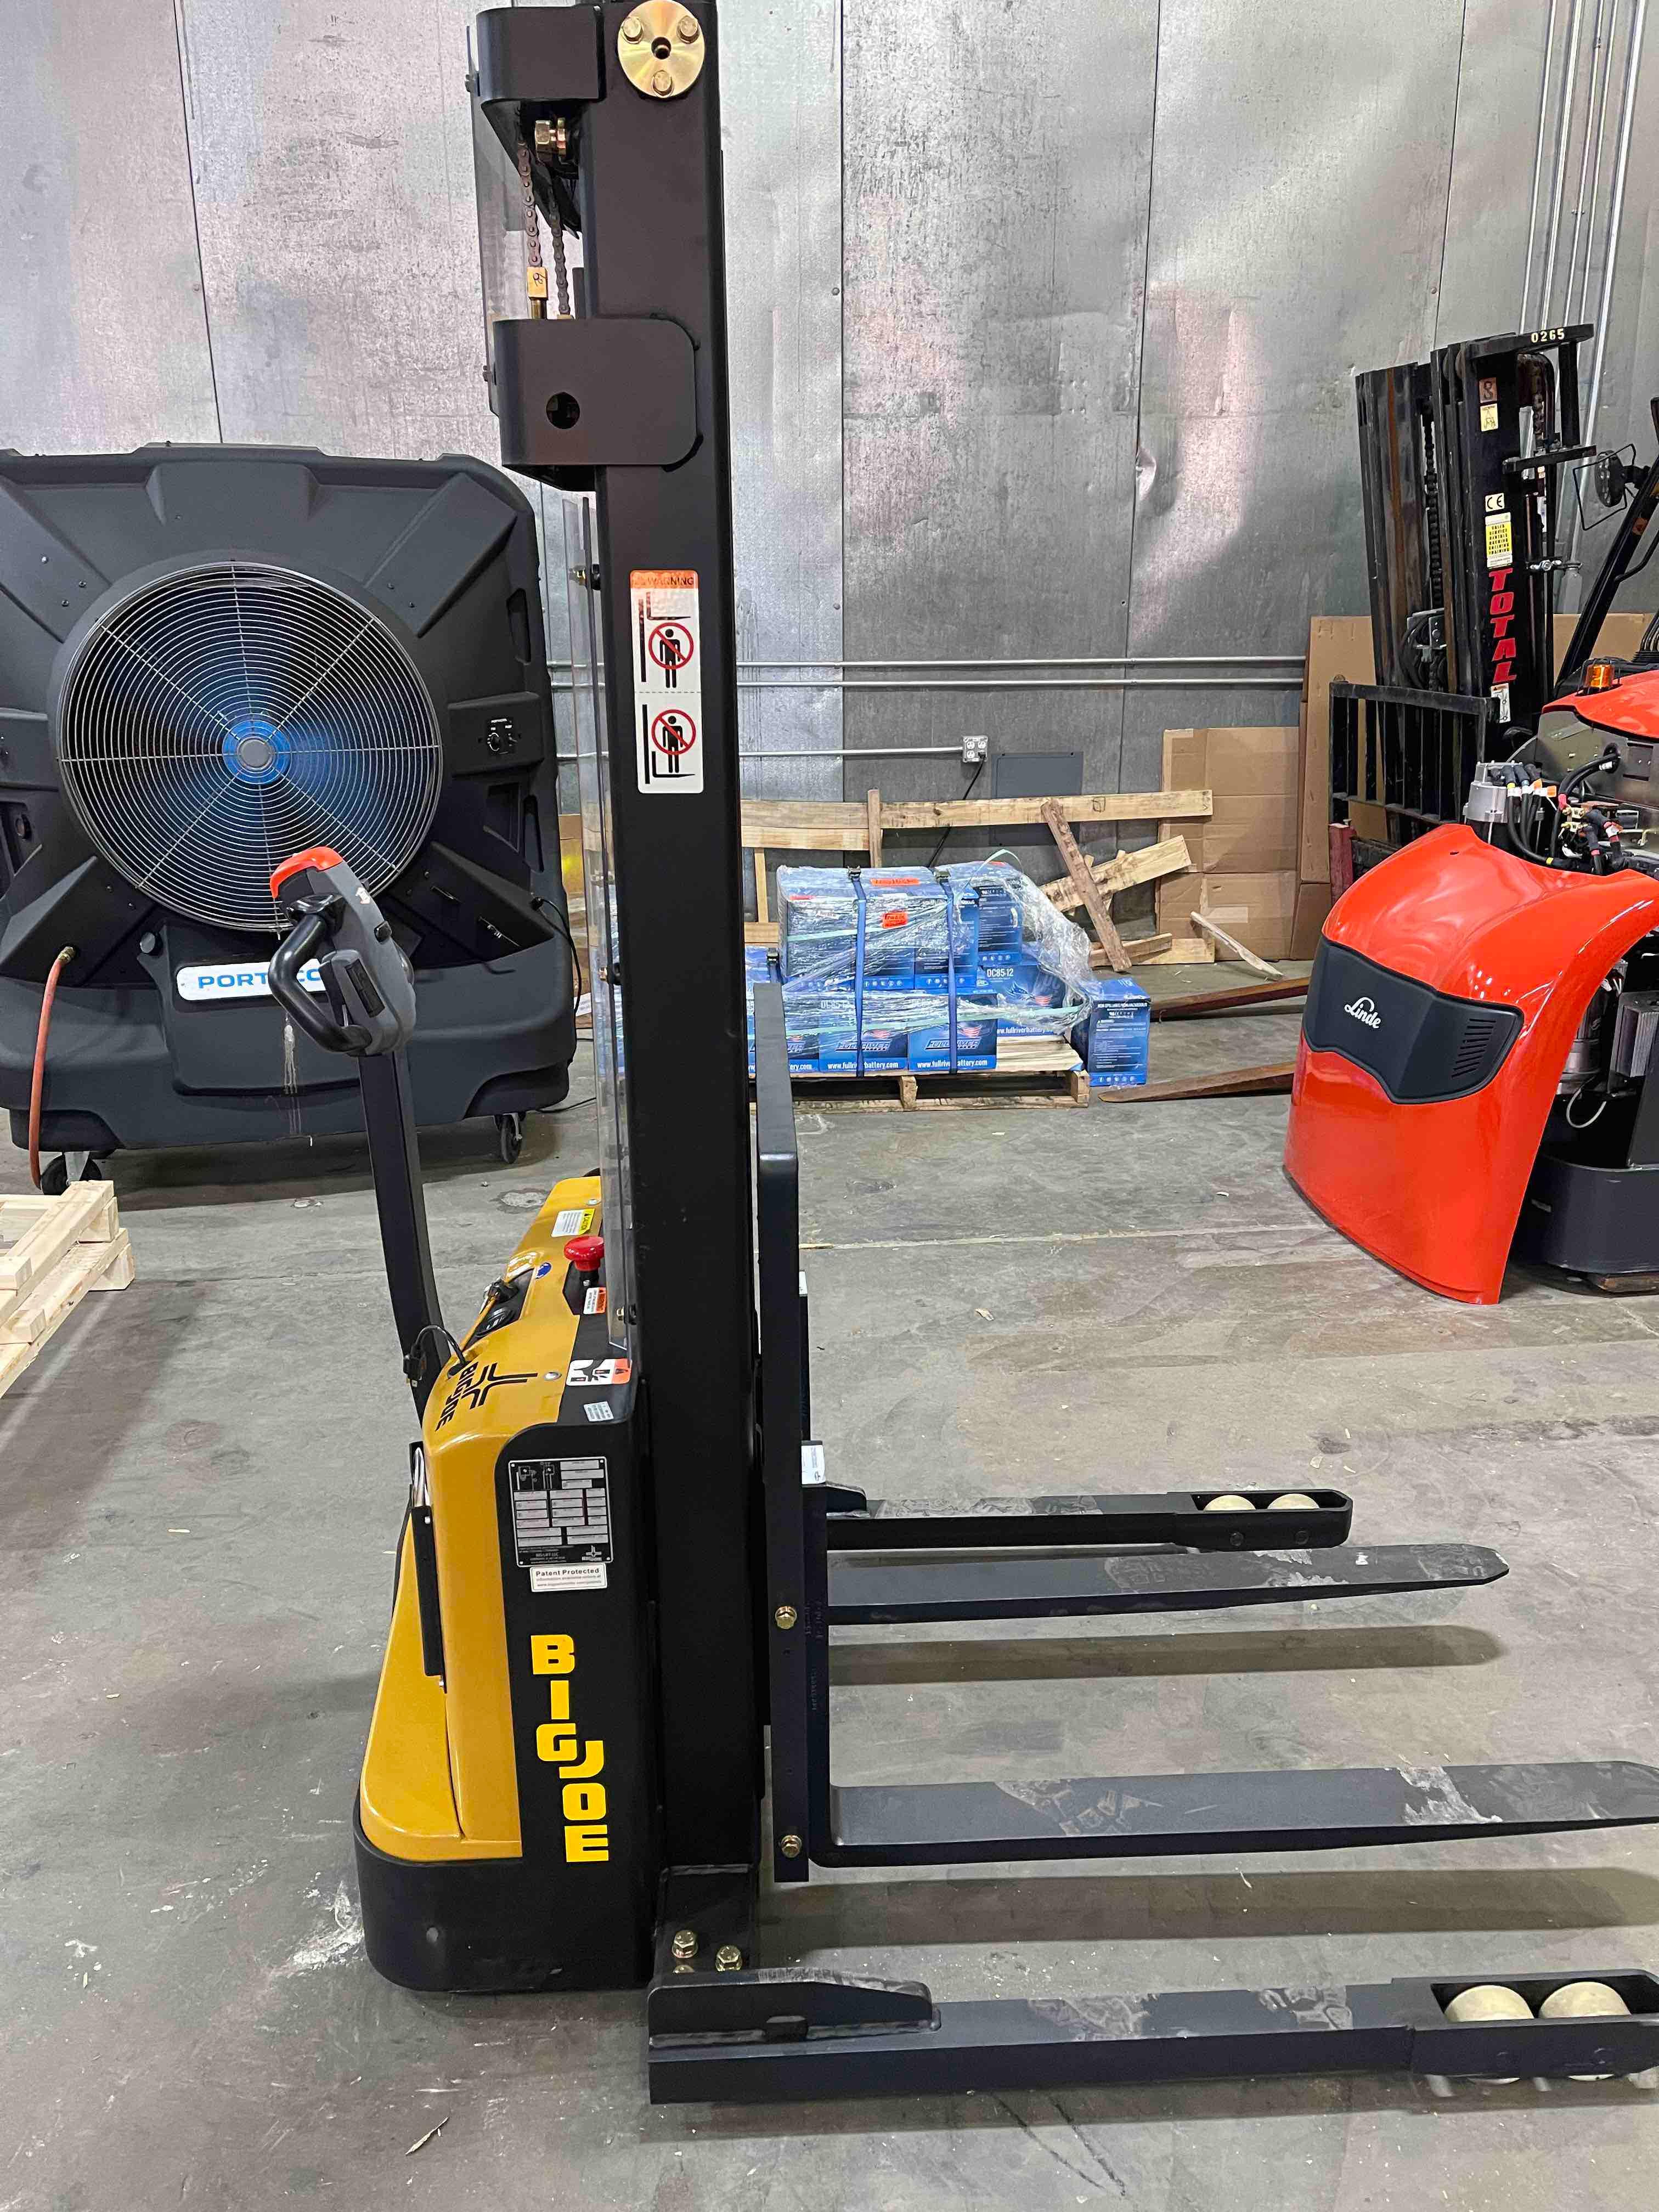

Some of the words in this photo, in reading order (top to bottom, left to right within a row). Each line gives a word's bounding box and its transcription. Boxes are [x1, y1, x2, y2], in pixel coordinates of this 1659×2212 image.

[1531, 328, 1565, 343] 0265
[1488, 568, 1516, 682] TOTAL
[1344, 996, 1381, 1029] Linde
[827, 1061, 899, 1071] www.fullribattery.com
[917, 1059, 988, 1068] www.fullriveattery.com
